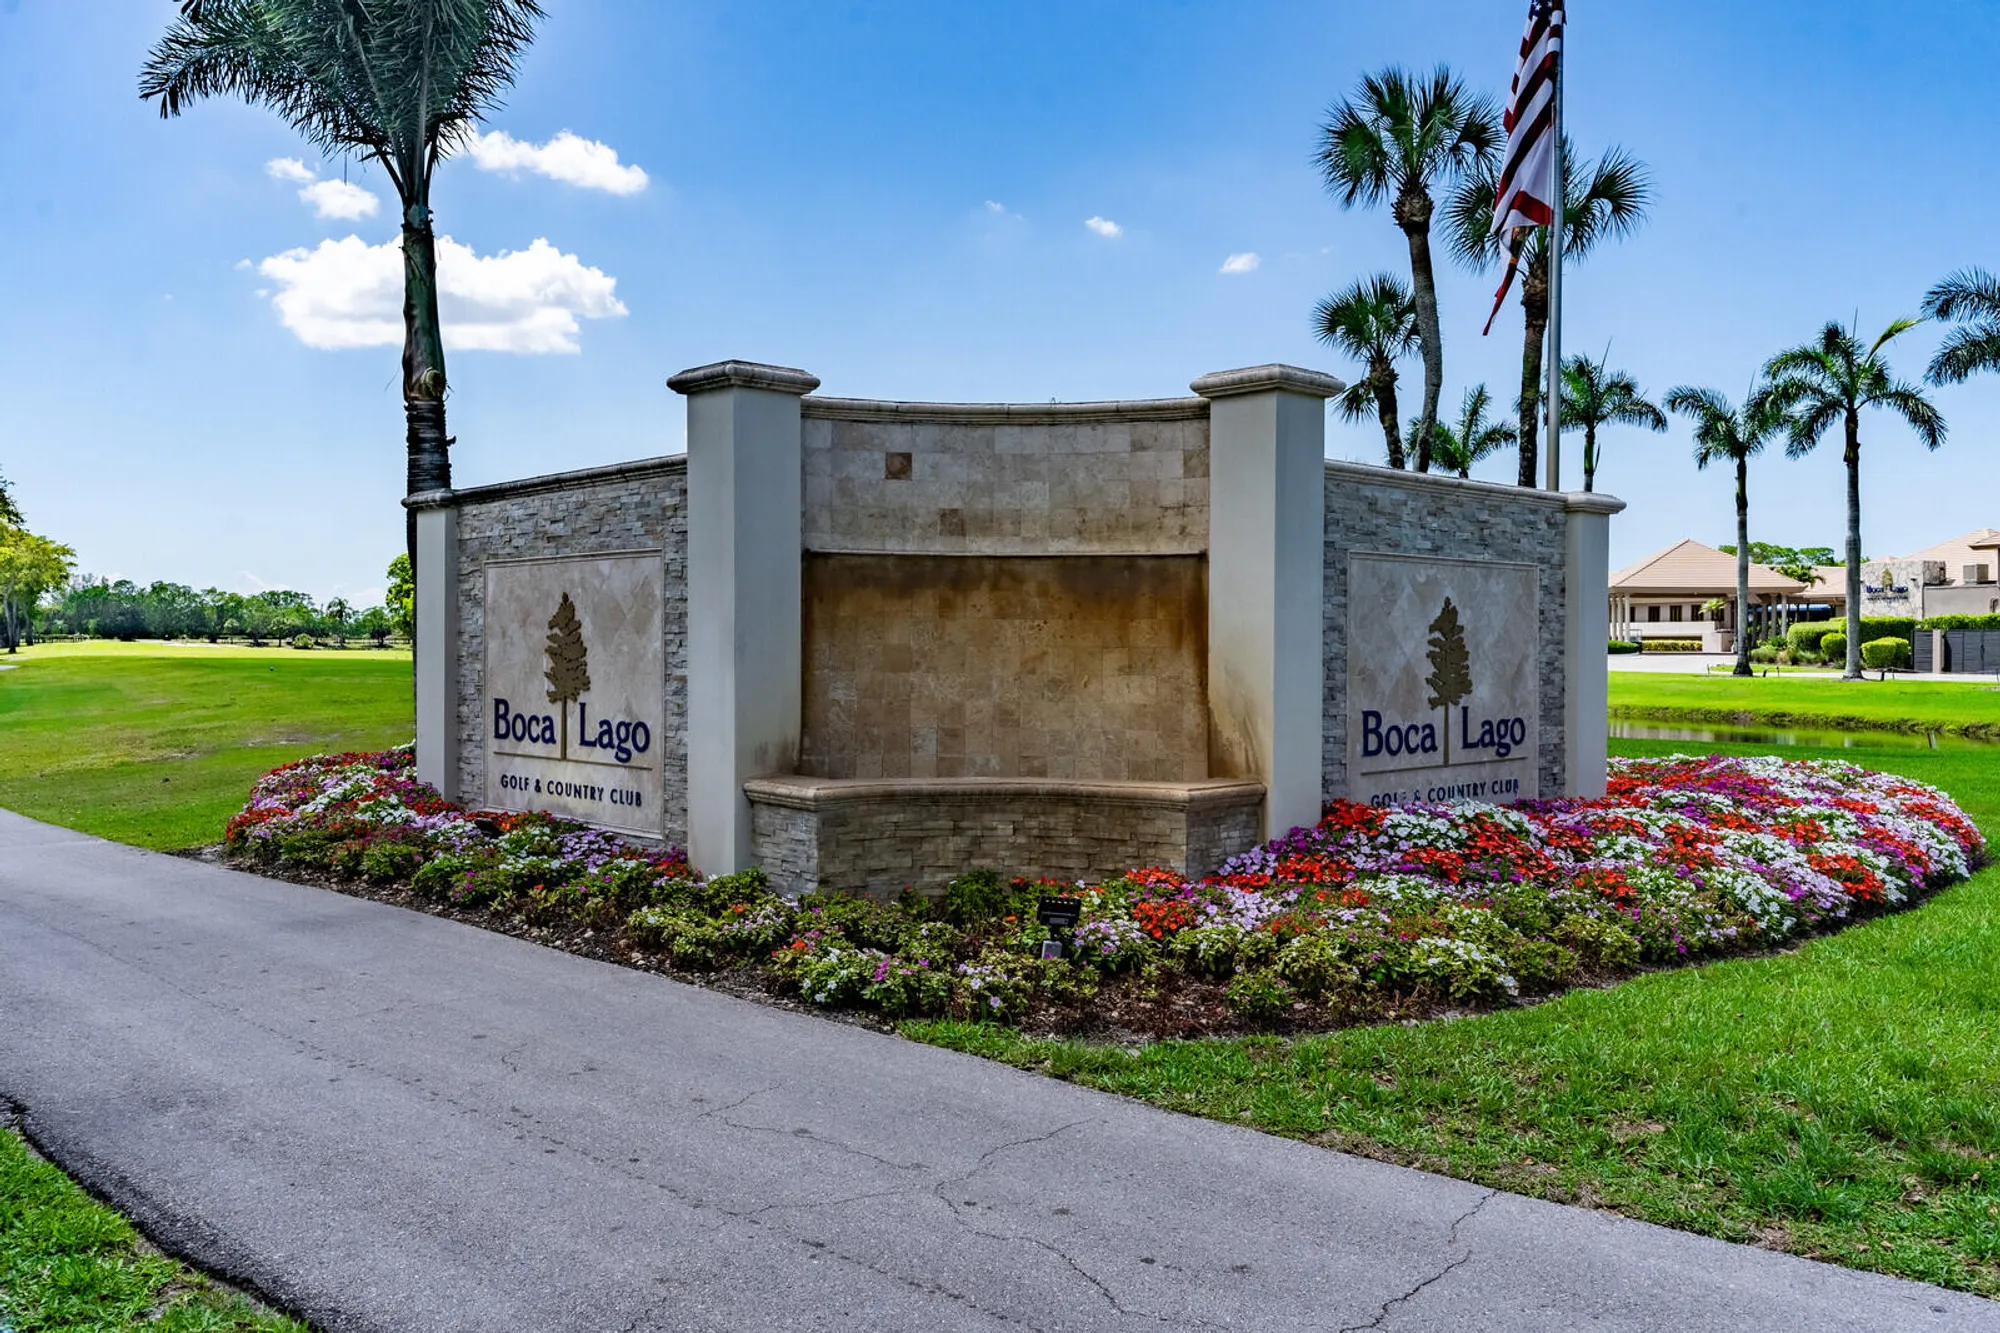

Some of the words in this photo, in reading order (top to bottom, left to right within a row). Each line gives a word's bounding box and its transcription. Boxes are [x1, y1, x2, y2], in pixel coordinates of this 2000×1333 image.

[494, 698, 556, 744] Boca
[579, 702, 651, 763] Lago
[1362, 710, 1438, 757] Boca
[1461, 706, 1526, 757] Lago
[500, 774, 529, 791] GOLF
[534, 779, 542, 793] &
[547, 780, 604, 801] COUNTRY
[610, 788, 642, 807] CLUB
[1413, 790, 1421, 803] &
[1427, 781, 1487, 803] COUNTRY
[1492, 778, 1519, 794] CLUB
